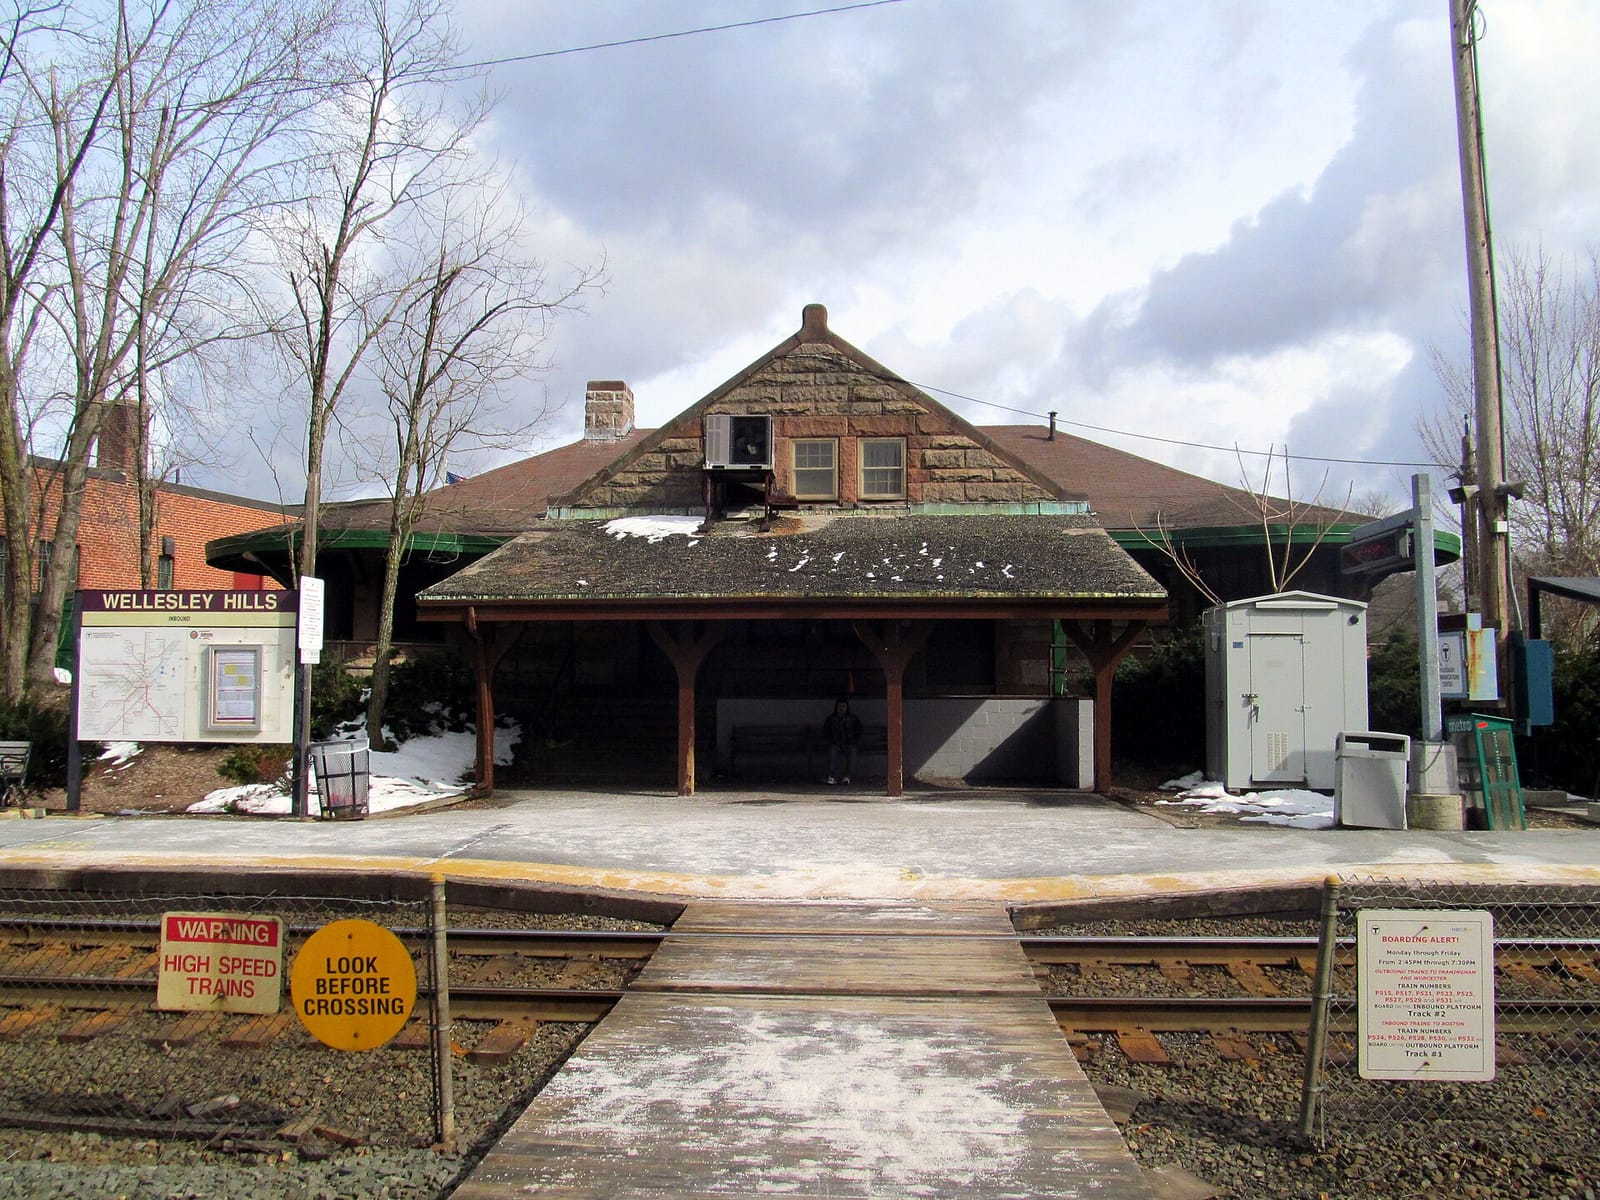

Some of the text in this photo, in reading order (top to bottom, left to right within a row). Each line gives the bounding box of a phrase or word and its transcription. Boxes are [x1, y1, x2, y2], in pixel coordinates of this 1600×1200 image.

[103, 593, 278, 610] WELLESLEY HILLS
[1448, 720, 1473, 732] metro
[177, 920, 270, 943] WARNING
[164, 955, 277, 978] HIGH SPEED
[326, 956, 378, 974] LOOK
[186, 977, 255, 999] TRAINS
[315, 977, 390, 995] BEFORE
[303, 998, 405, 1016] CROSSING
